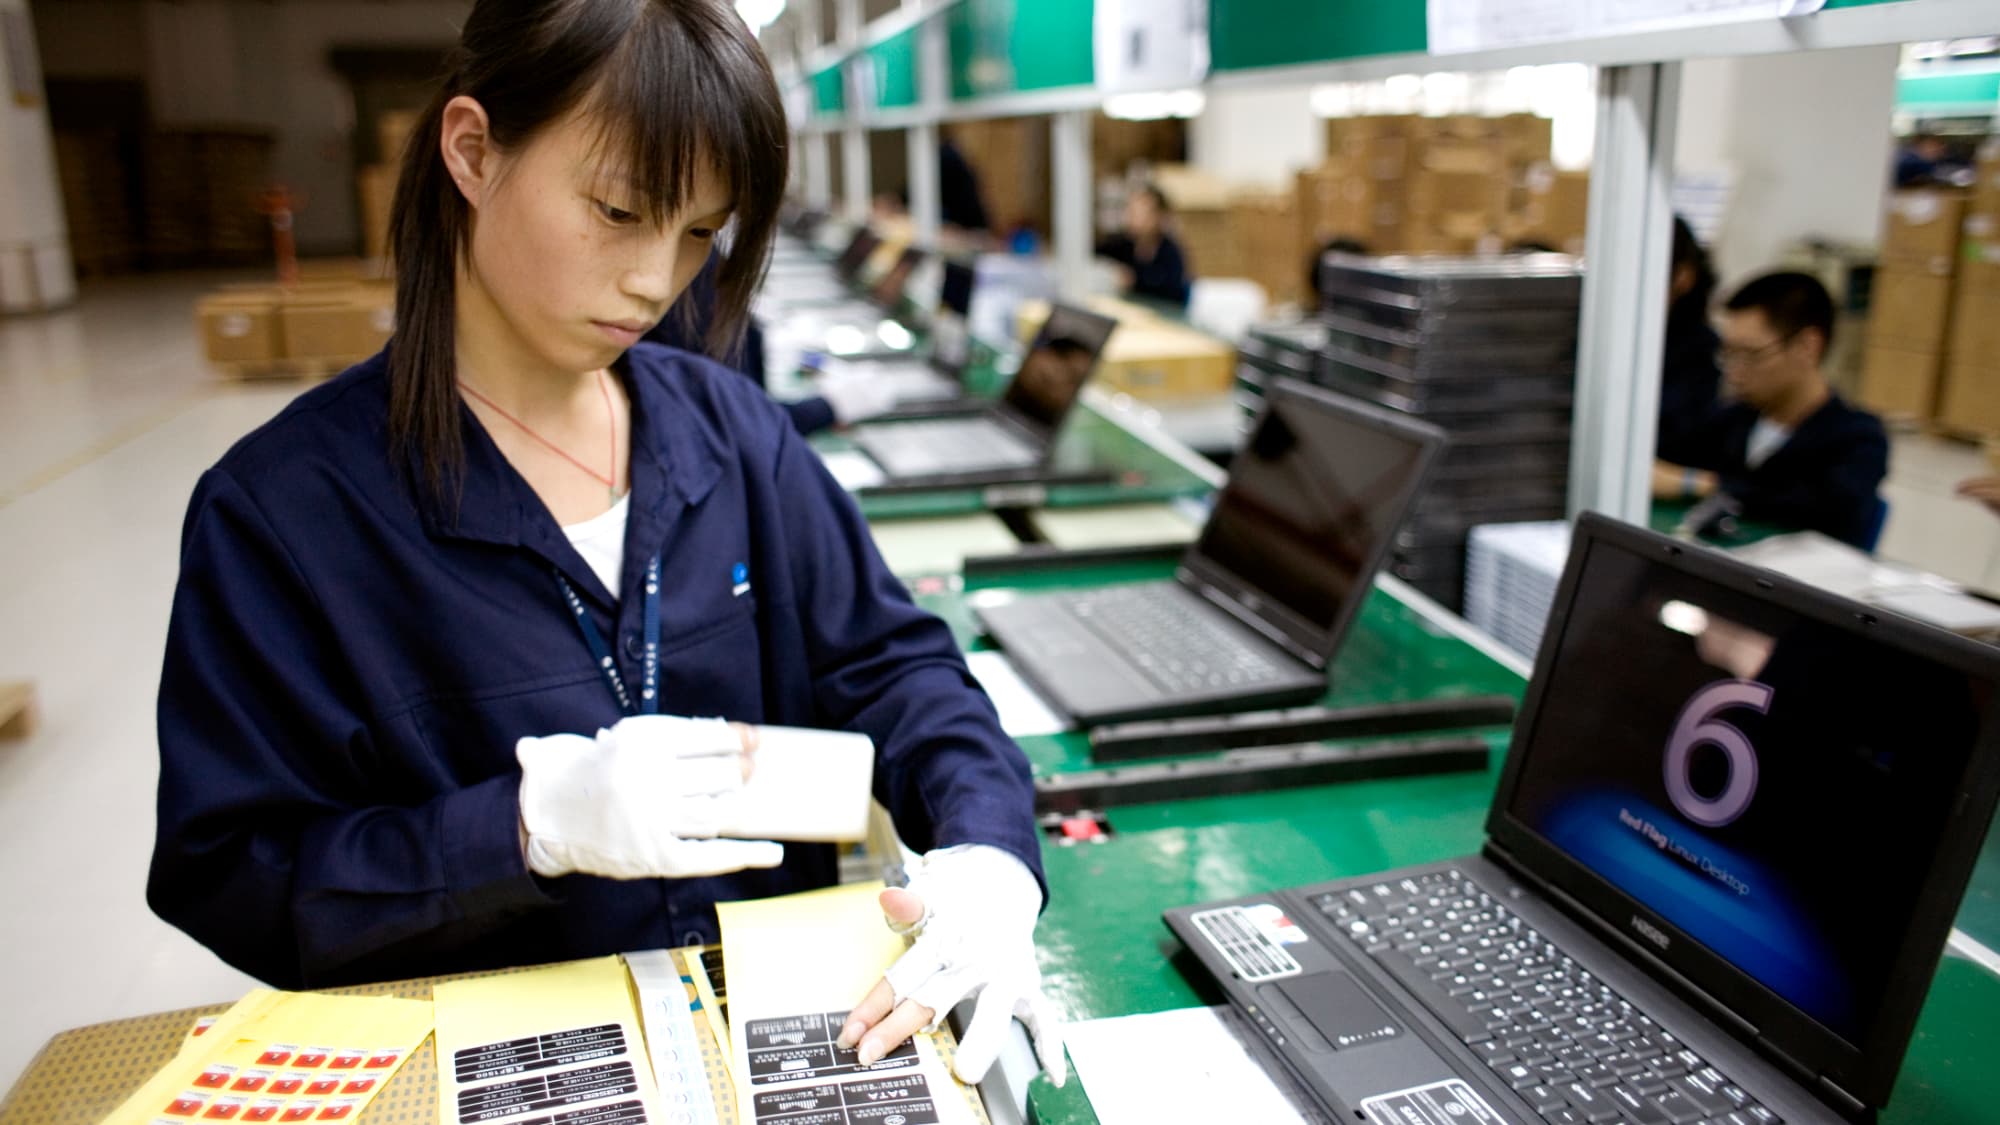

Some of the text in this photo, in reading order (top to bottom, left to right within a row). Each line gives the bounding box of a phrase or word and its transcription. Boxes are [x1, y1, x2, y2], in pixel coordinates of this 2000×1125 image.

[1662, 678, 1775, 827] 6
[1618, 808, 1750, 895] Red Flag Linux Desktop
[868, 1088, 909, 1100] SATA
